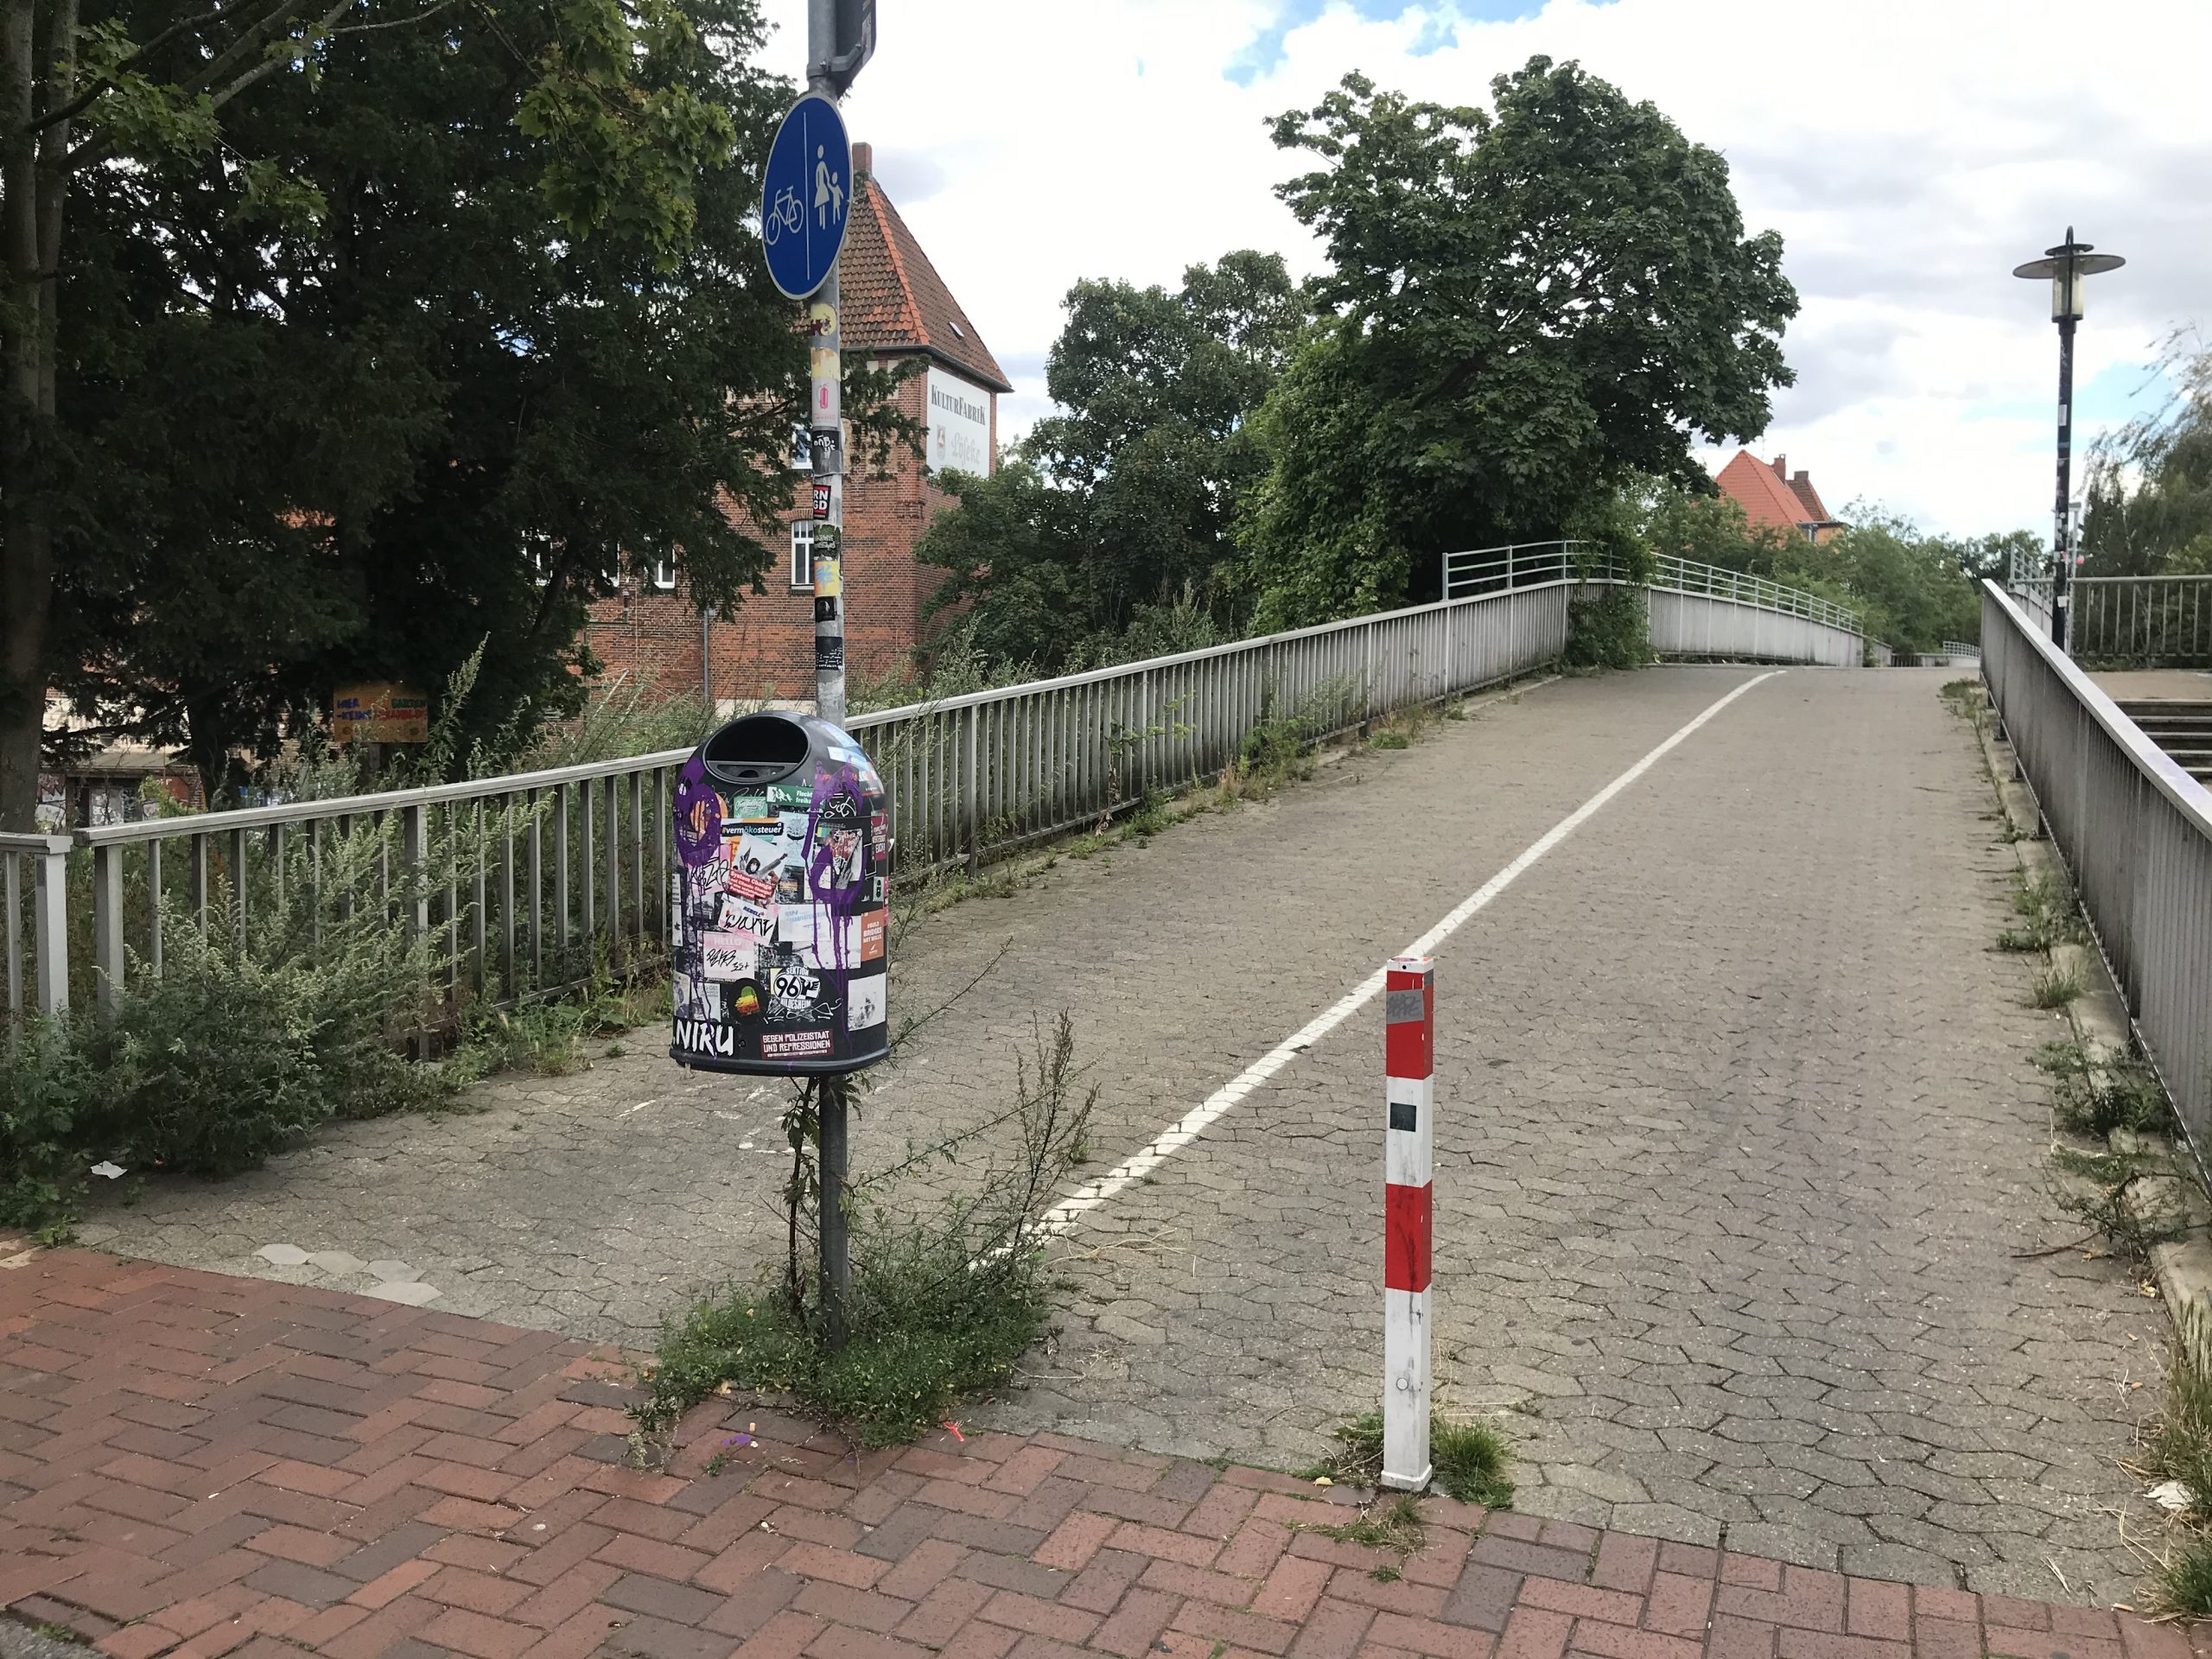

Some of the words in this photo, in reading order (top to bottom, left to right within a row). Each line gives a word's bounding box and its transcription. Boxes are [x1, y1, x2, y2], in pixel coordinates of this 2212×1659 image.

[730, 870, 751, 882] System
[751, 877, 772, 890] Change
[776, 977, 799, 998] 96
[676, 1019, 734, 1057] NIRU
[762, 1034, 784, 1044] GEGEN
[785, 1031, 830, 1043] POLIZEISTAAT
[763, 1044, 779, 1053] UND
[779, 1039, 830, 1052] REPRESSIONEN
